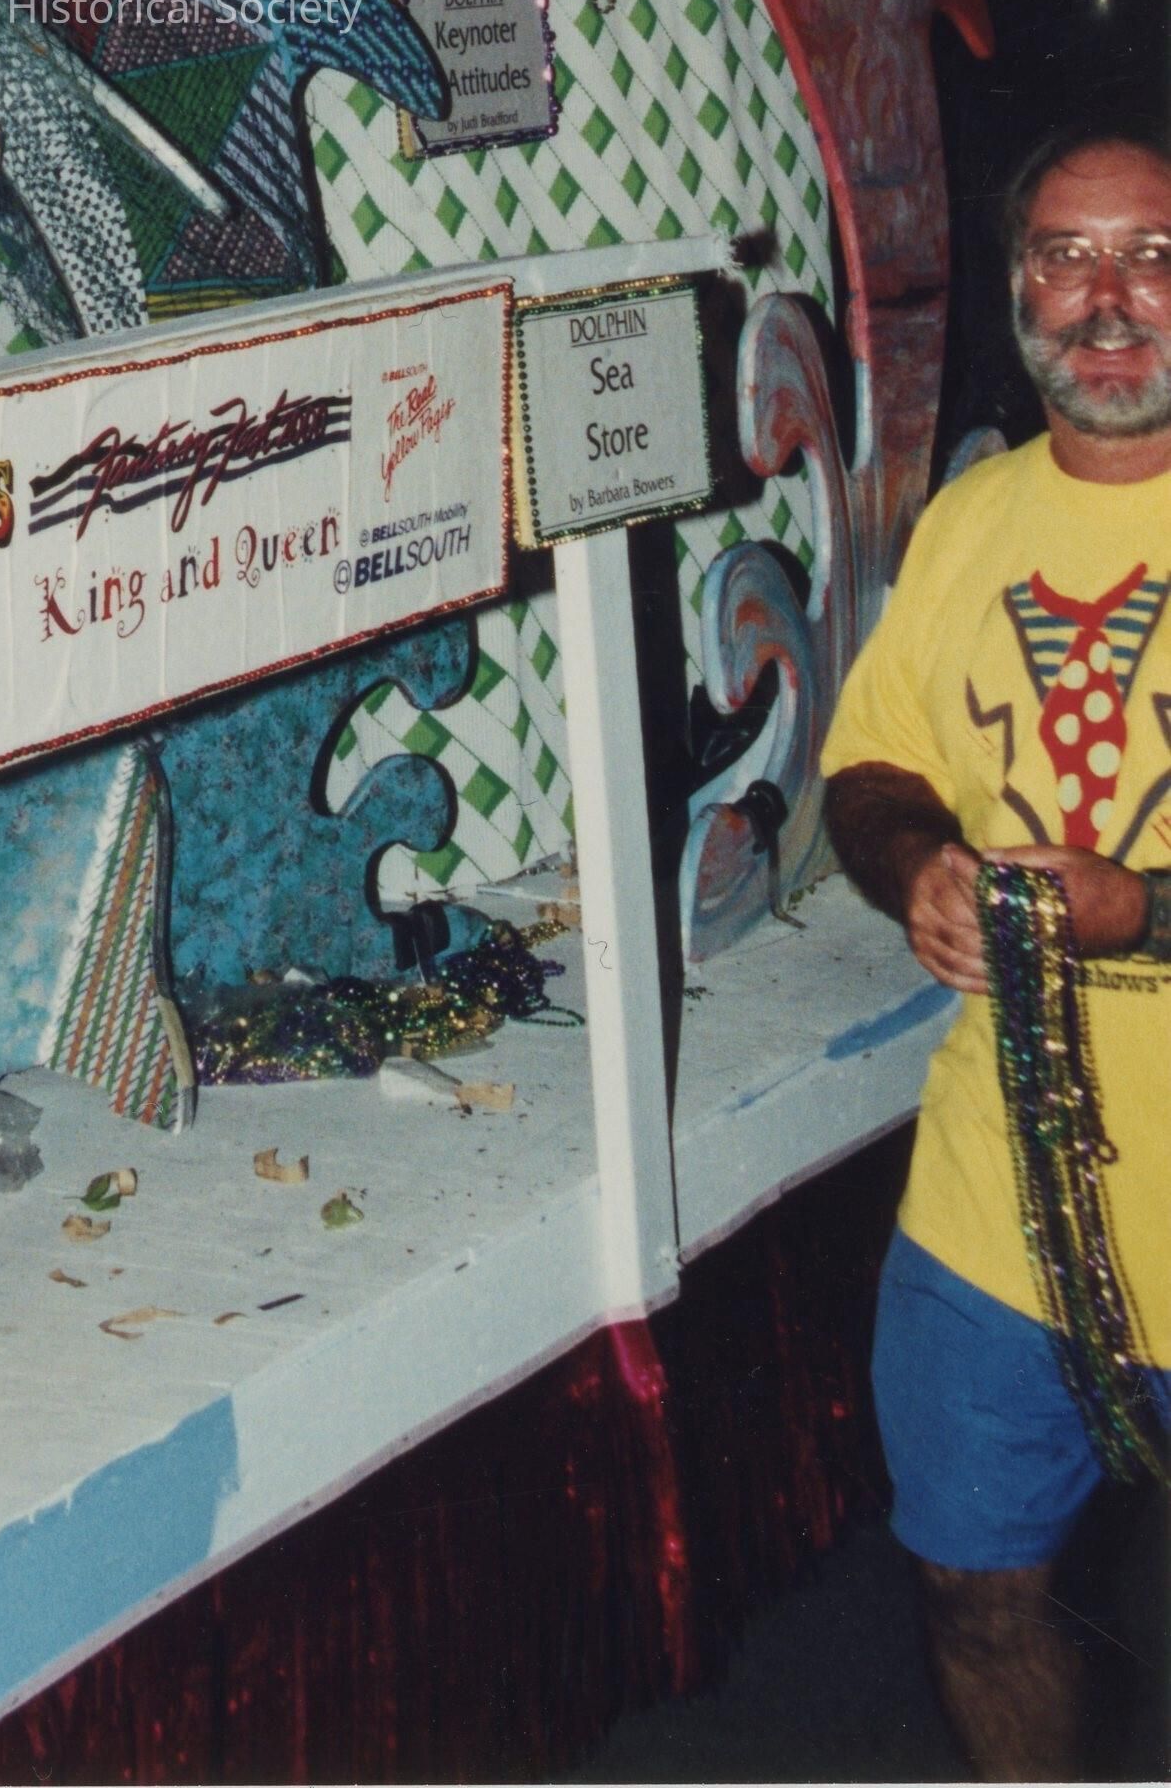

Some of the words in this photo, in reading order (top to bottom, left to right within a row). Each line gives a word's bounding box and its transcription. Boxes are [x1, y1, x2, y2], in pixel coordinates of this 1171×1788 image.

[435, 21, 517, 55] Keynoter
[449, 63, 531, 97] Attitudes
[569, 308, 647, 343] DOLPHIN
[590, 357, 634, 394] Sea
[586, 422, 648, 461] Store
[569, 493, 585, 515] by
[587, 483, 631, 508] Barbara
[633, 474, 676, 498] Bowers
[372, 513, 431, 543] BELLSOUTH
[354, 524, 471, 588] BELLSOUTH
[34, 567, 147, 642] King
[160, 536, 221, 602] and
[235, 514, 340, 588] Queen
